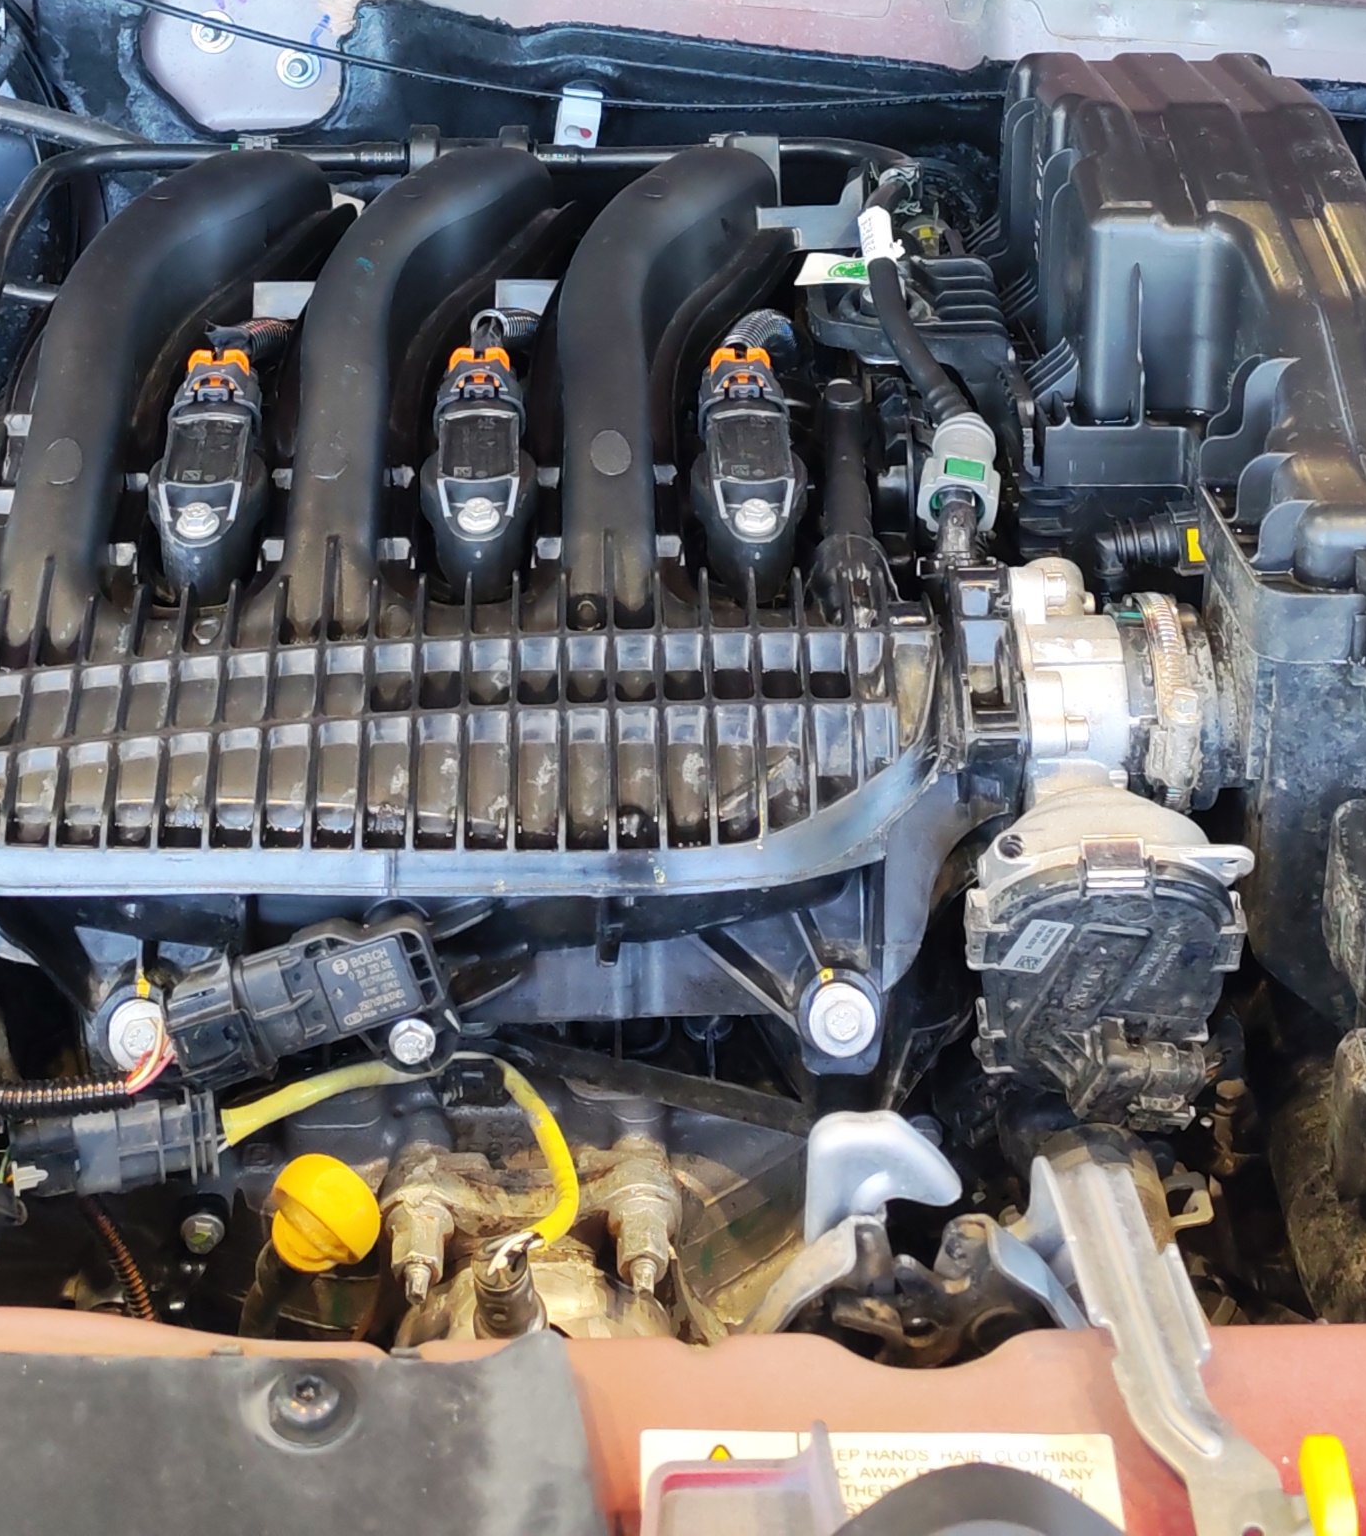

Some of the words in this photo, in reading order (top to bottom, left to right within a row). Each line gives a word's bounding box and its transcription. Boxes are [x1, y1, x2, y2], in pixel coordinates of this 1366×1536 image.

[349, 947, 388, 968] BOSCH
[837, 1449, 860, 1462] EP
[866, 1449, 929, 1462] HANDS
[940, 1450, 982, 1462] HAIR
[995, 1450, 1093, 1464] CLOTHING.
[860, 1467, 908, 1479] AWAY
[1059, 1468, 1094, 1480] ANY
[843, 1484, 893, 1498] THER
